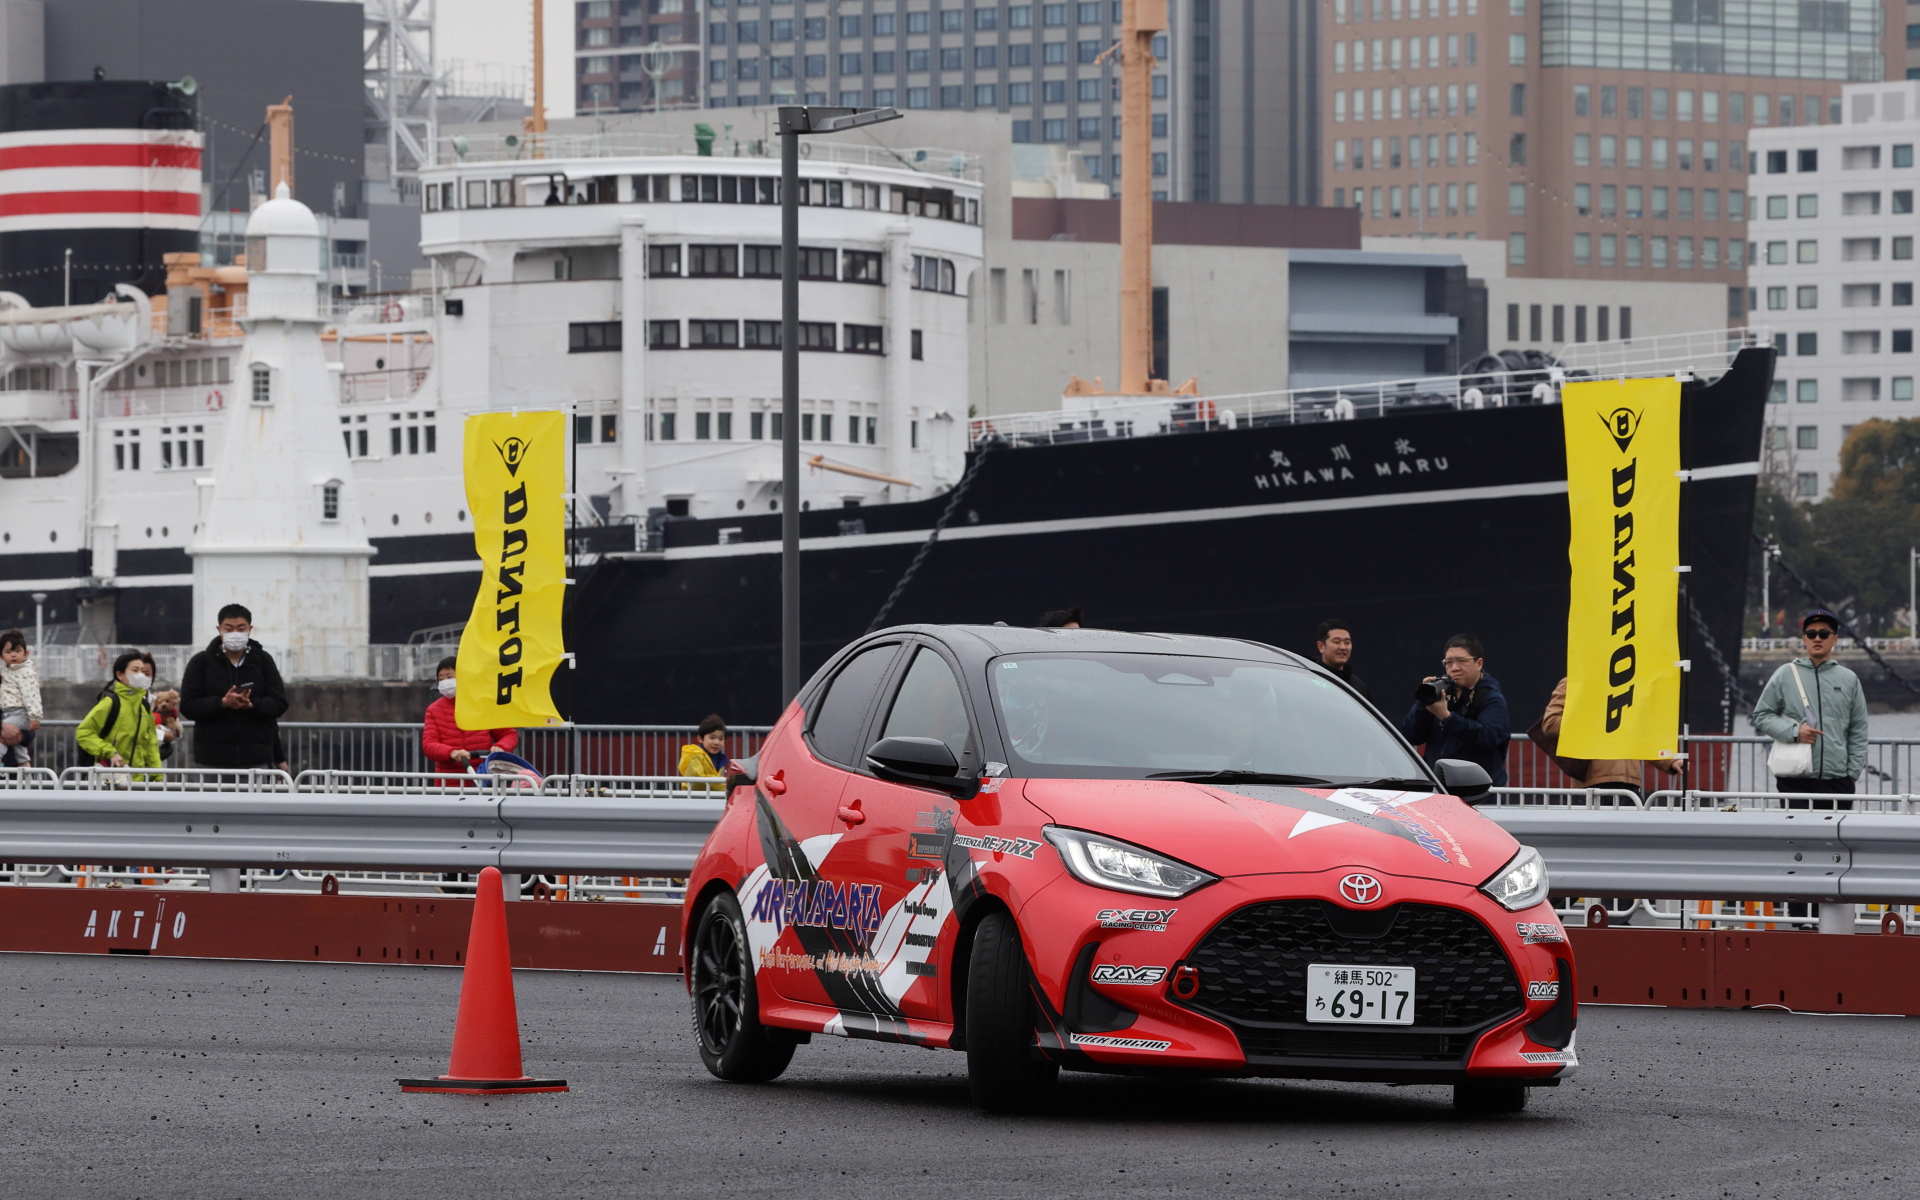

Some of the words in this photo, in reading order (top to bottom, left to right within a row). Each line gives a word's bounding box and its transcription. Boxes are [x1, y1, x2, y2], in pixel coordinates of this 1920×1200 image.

[1255, 467, 1354, 489] HIKAWA
[1375, 457, 1449, 476] MARU
[954, 835, 982, 847] POTENZA
[1097, 908, 1178, 923] EXEDY
[84, 898, 186, 950] AKTIO
[1102, 921, 1133, 929] RACING
[1134, 922, 1166, 931] CLUTCH
[1516, 922, 1560, 936] EXEDY
[1094, 967, 1165, 980] RAYS
[1334, 970, 1364, 986] 練馬
[1366, 971, 1392, 986] 502
[1529, 984, 1558, 995] RAYS
[1315, 995, 1325, 1011] ち
[1331, 989, 1409, 1020] 69-17
